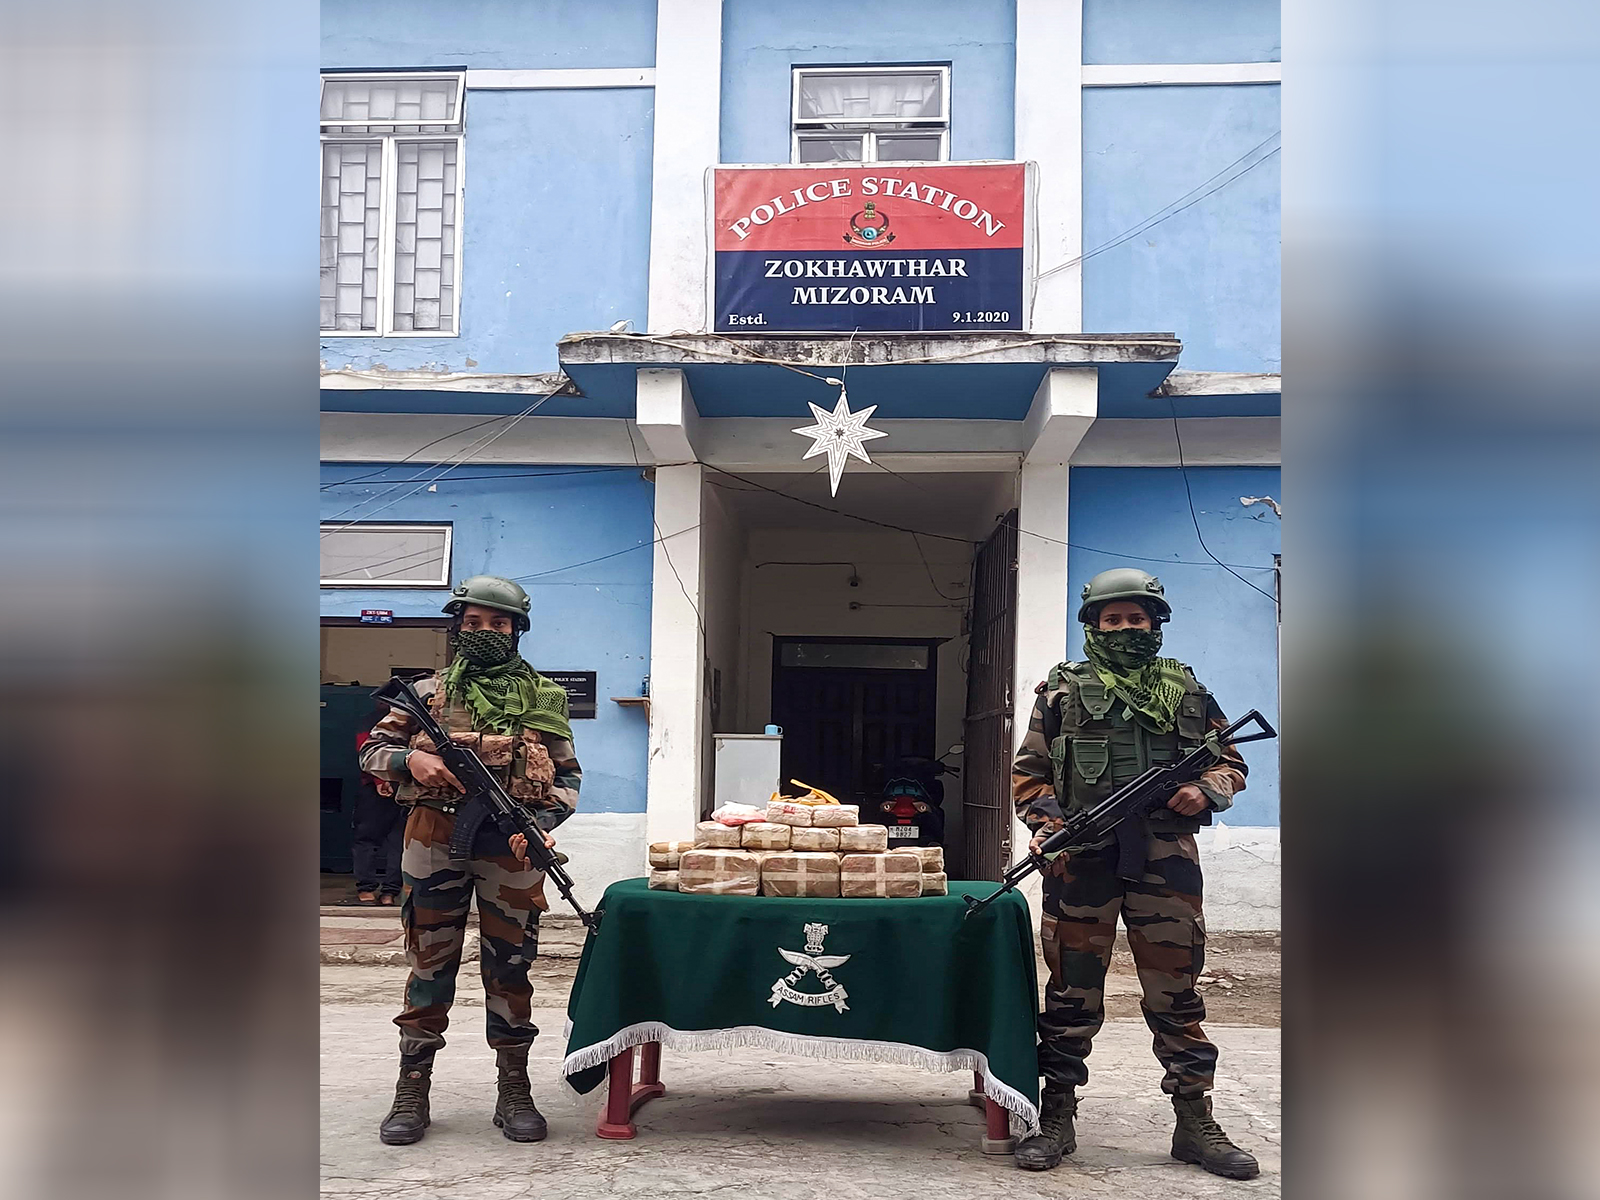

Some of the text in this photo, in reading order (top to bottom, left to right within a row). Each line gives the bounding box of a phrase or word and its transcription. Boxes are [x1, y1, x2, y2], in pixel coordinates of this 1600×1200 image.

[728, 177, 1005, 241] POLICE STATION
[764, 258, 968, 279] ZOKHAWTHAR
[791, 286, 936, 305] MIZORAM
[728, 313, 768, 326] Estd.
[952, 311, 1010, 323] 9.1.2020
[777, 986, 840, 1005] ASSAM RIFLES
